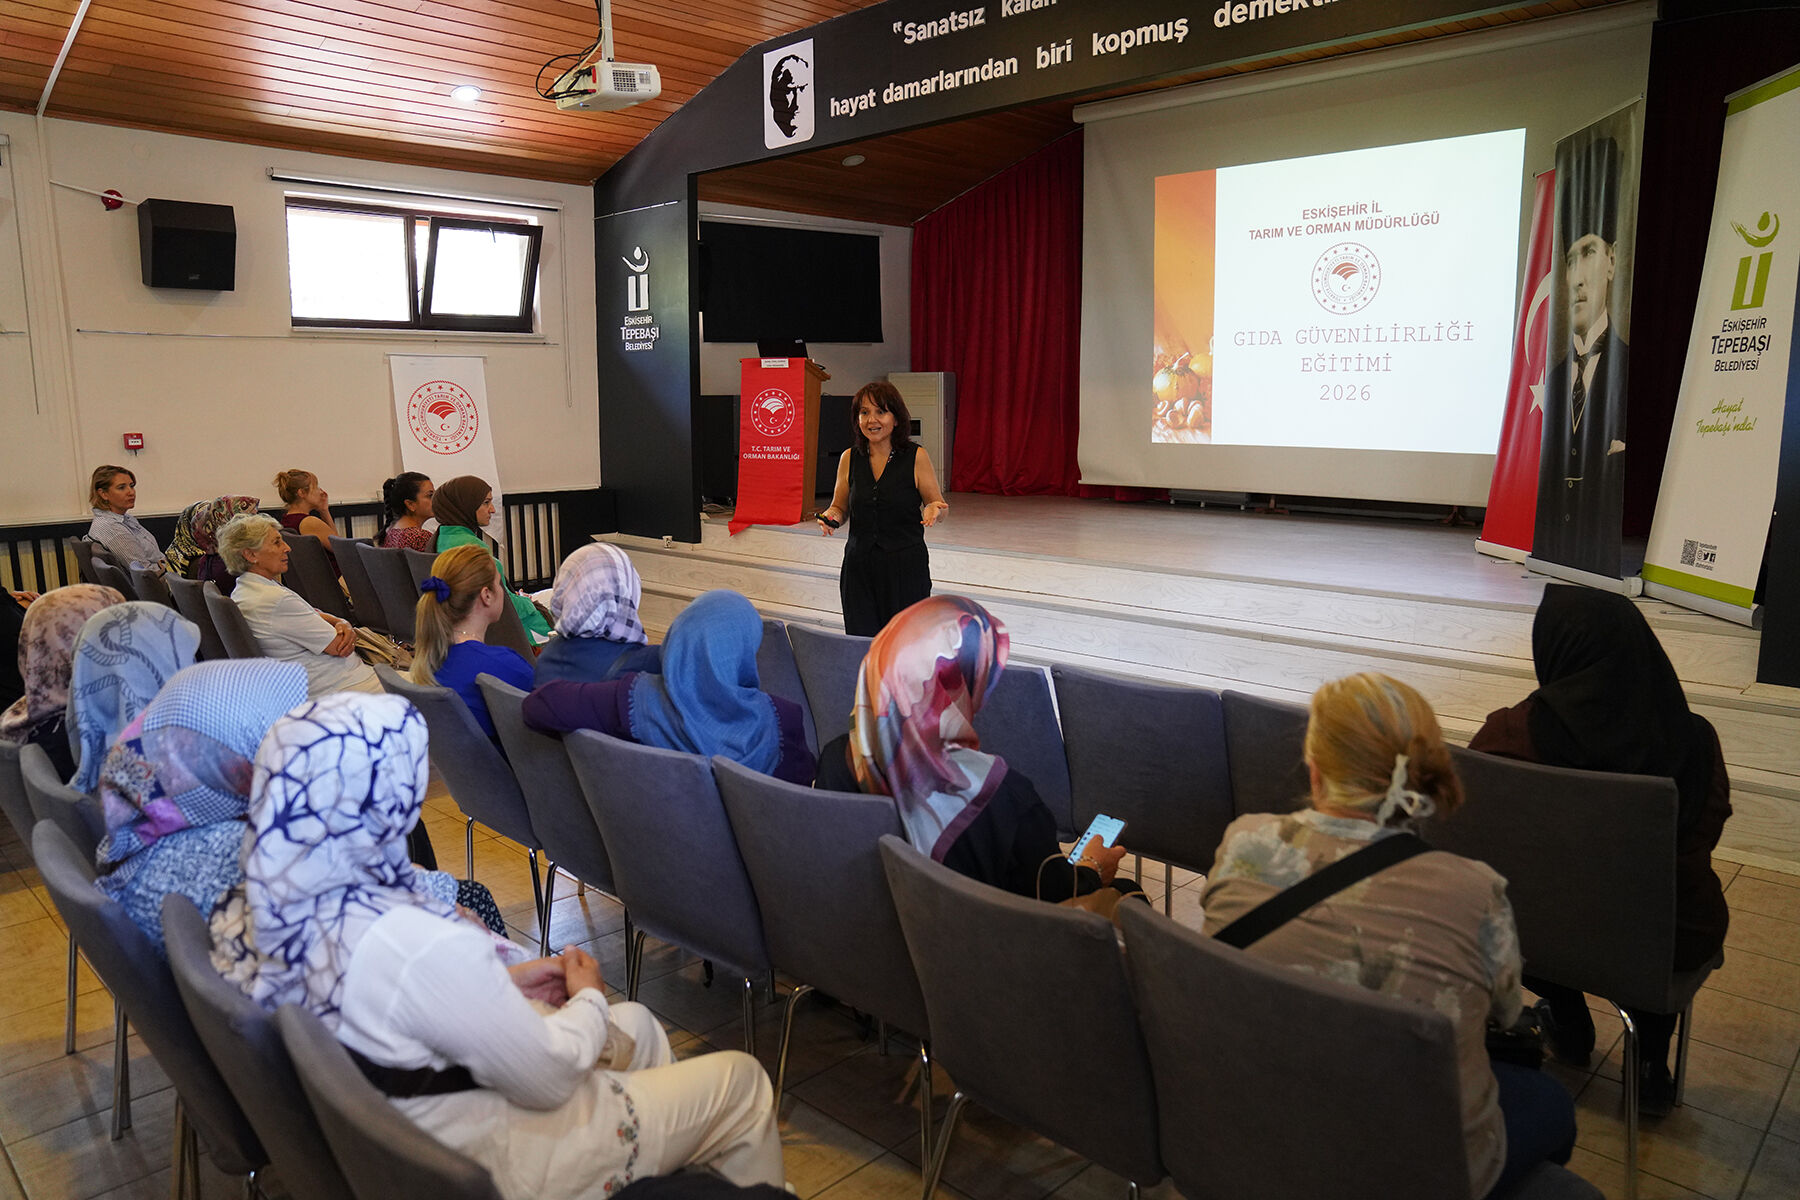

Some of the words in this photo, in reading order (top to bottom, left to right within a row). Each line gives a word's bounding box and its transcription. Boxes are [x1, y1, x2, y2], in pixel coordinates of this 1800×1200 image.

[830, 89, 876, 118] hayat
[883, 54, 1018, 105] damarlarından
[1036, 38, 1072, 70] biri
[1092, 15, 1189, 56] kopmuş
[1302, 203, 1368, 220] ESKİŞEHİR
[1371, 200, 1383, 215] İL
[1249, 227, 1284, 240] TARIM
[1287, 225, 1303, 237] VE
[1305, 221, 1351, 236] ORMAN
[1355, 211, 1440, 232] MÜDÜRLÜĞÜ
[620, 327, 659, 341] TEPEBAŞI
[1234, 330, 1283, 346] GIDA
[1295, 321, 1474, 344] GÜVENİLİRLİĞİ
[1722, 316, 1767, 333] ESKİŞEHİR
[1711, 334, 1771, 356] TEPEBAŞI
[1301, 352, 1392, 373] EĞİTİMİ
[1714, 358, 1759, 371] BELEDİYESİ
[1319, 385, 1371, 401] 2026
[1711, 397, 1745, 417] Hayat
